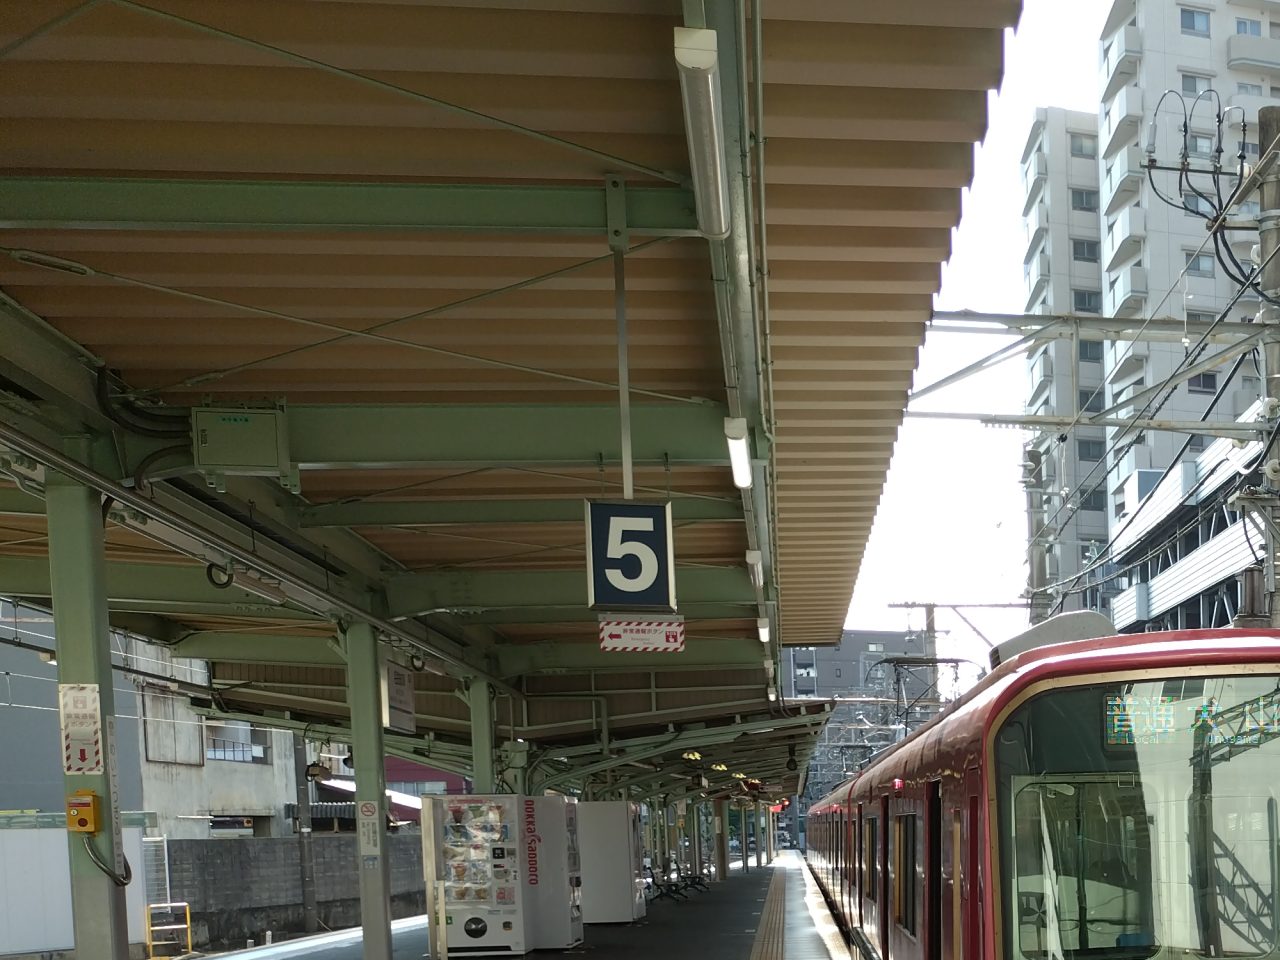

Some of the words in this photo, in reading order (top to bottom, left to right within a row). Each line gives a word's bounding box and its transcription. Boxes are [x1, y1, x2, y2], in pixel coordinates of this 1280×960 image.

[605, 516, 659, 592] 5
[1106, 696, 1175, 733] 普通
[1126, 734, 1159, 744] Local
